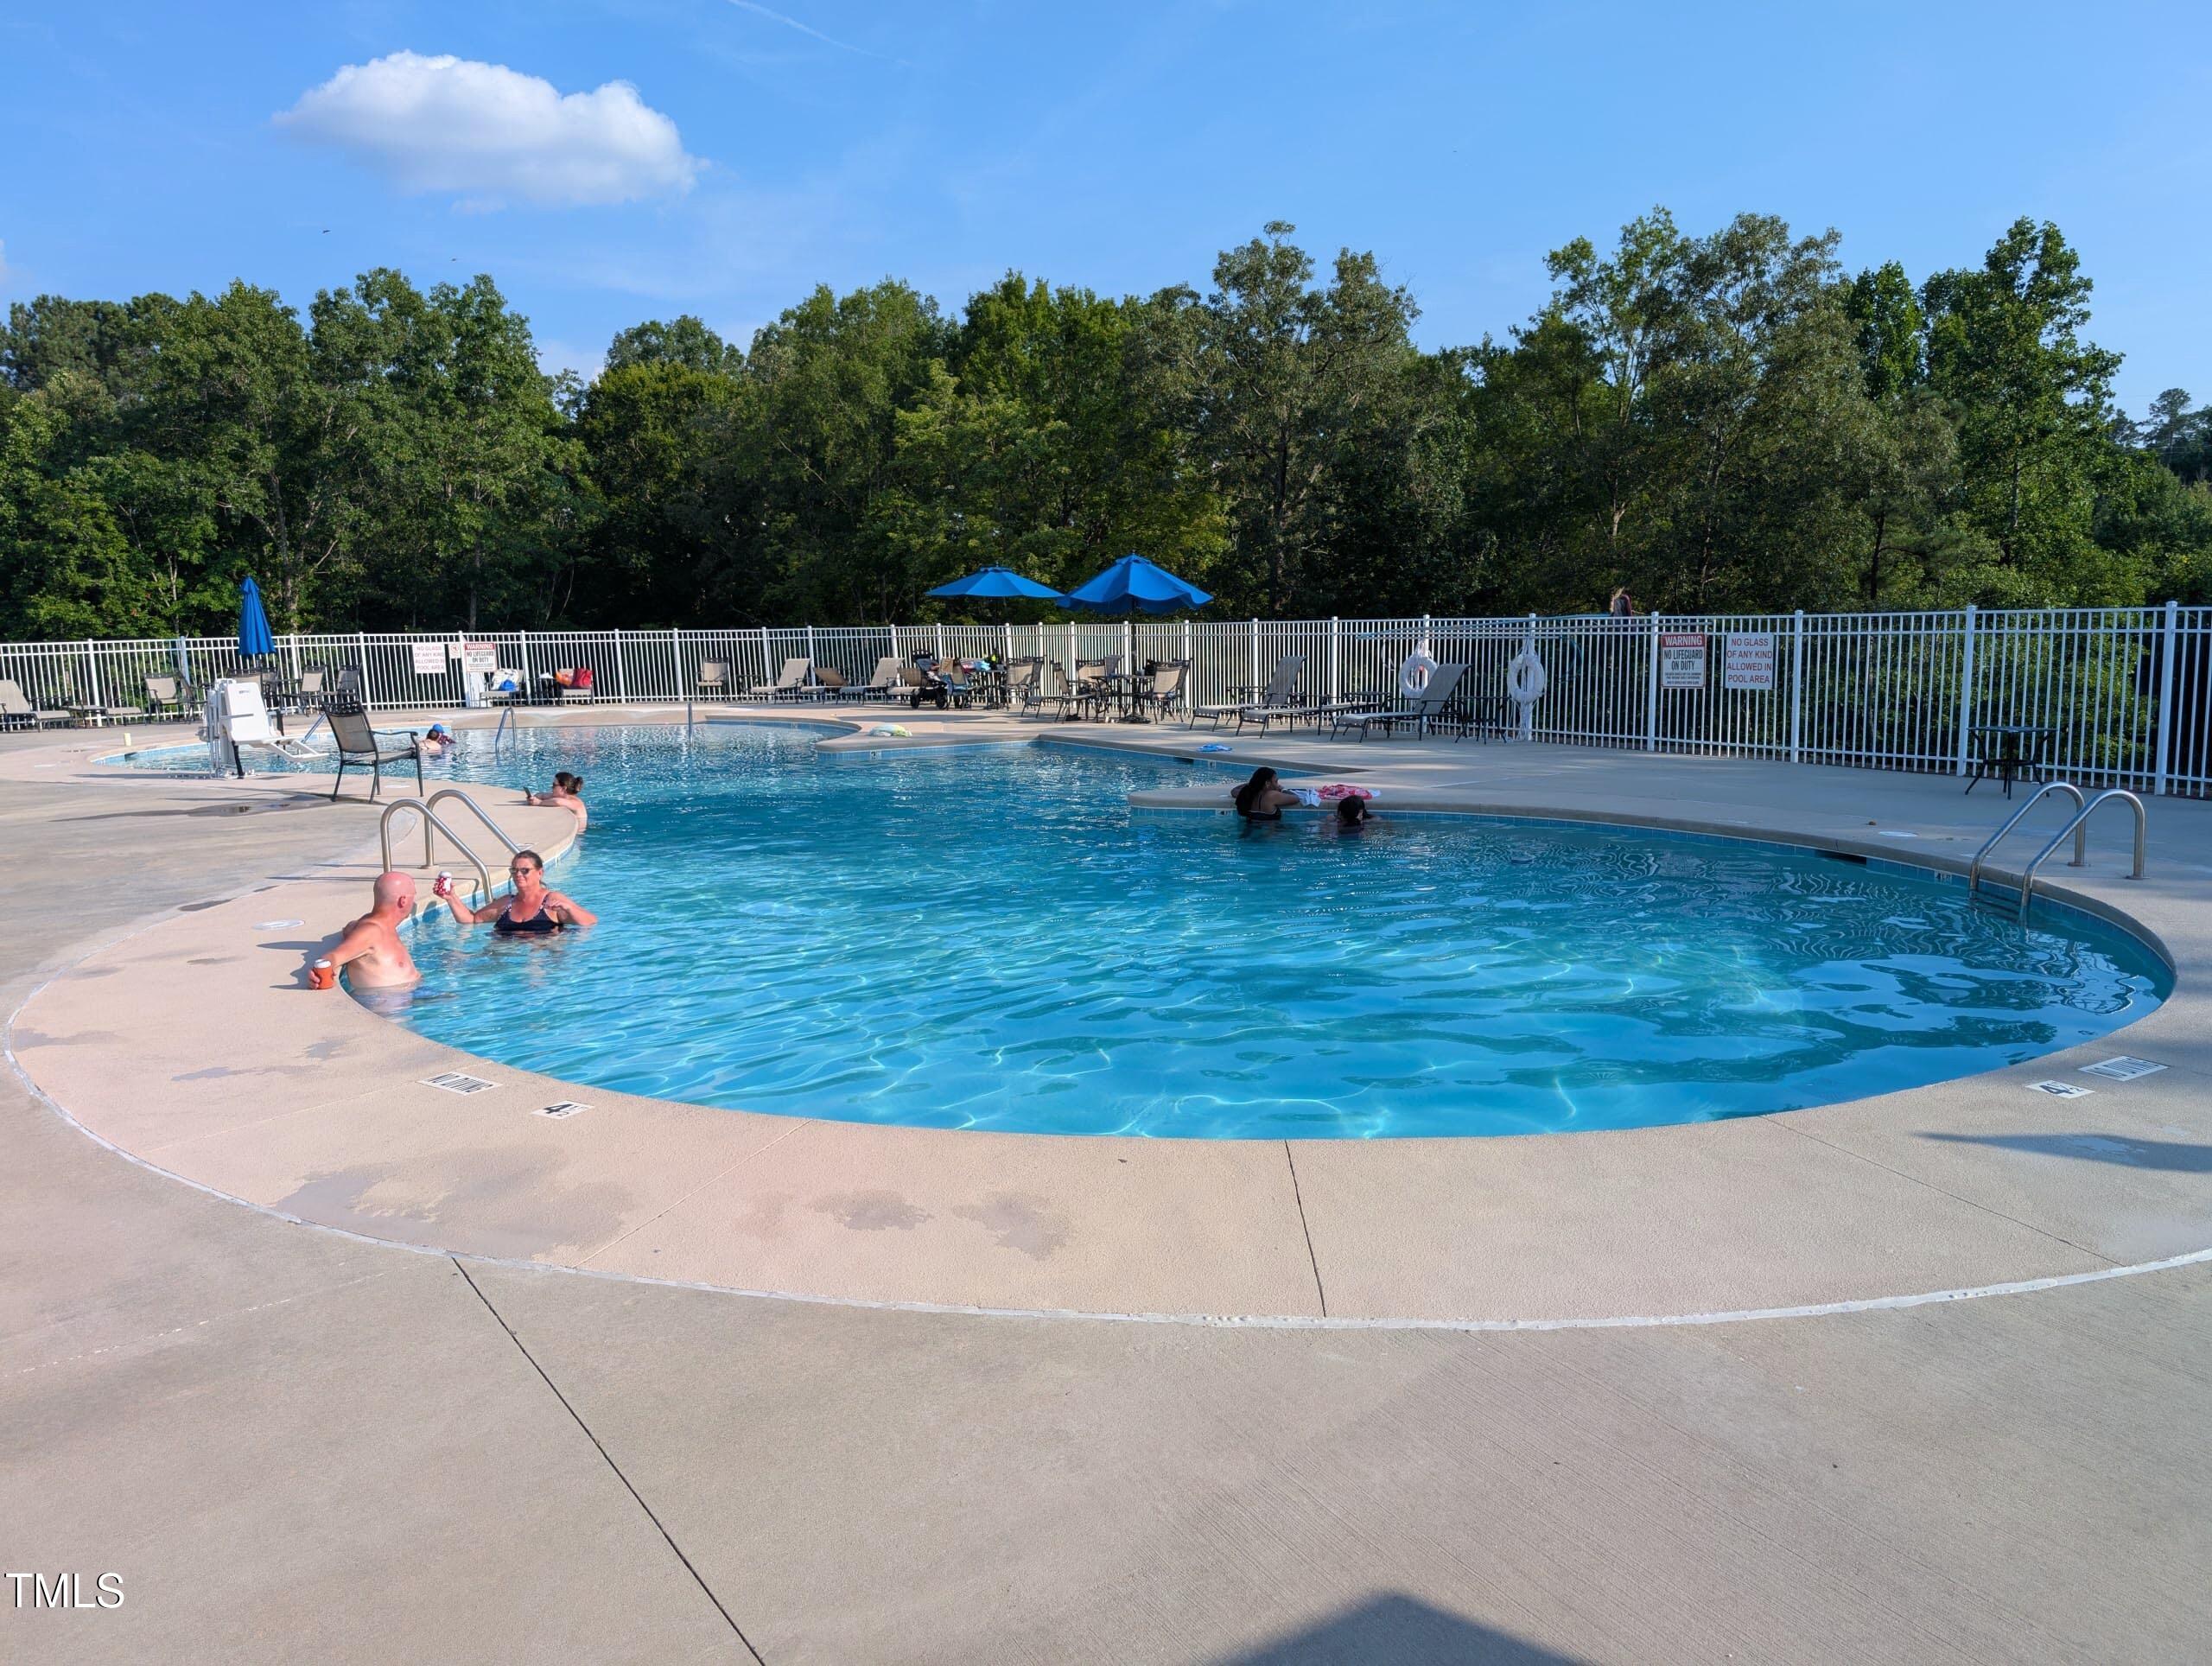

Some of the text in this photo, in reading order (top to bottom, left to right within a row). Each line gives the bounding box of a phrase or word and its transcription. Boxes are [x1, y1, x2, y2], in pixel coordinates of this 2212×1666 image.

[1664, 635, 1703, 646] WARNING
[1732, 638, 1769, 646] NO GLASS
[1664, 649, 1703, 659] NO LIFEGUARD
[1738, 650, 1753, 658] ANY
[1672, 660, 1694, 671] ON DUTY
[1727, 662, 1763, 671] ALLOWED
[1728, 674, 1770, 684] POOL AREA
[2039, 1084, 2074, 1094] 4
[543, 1103, 574, 1114] 4
